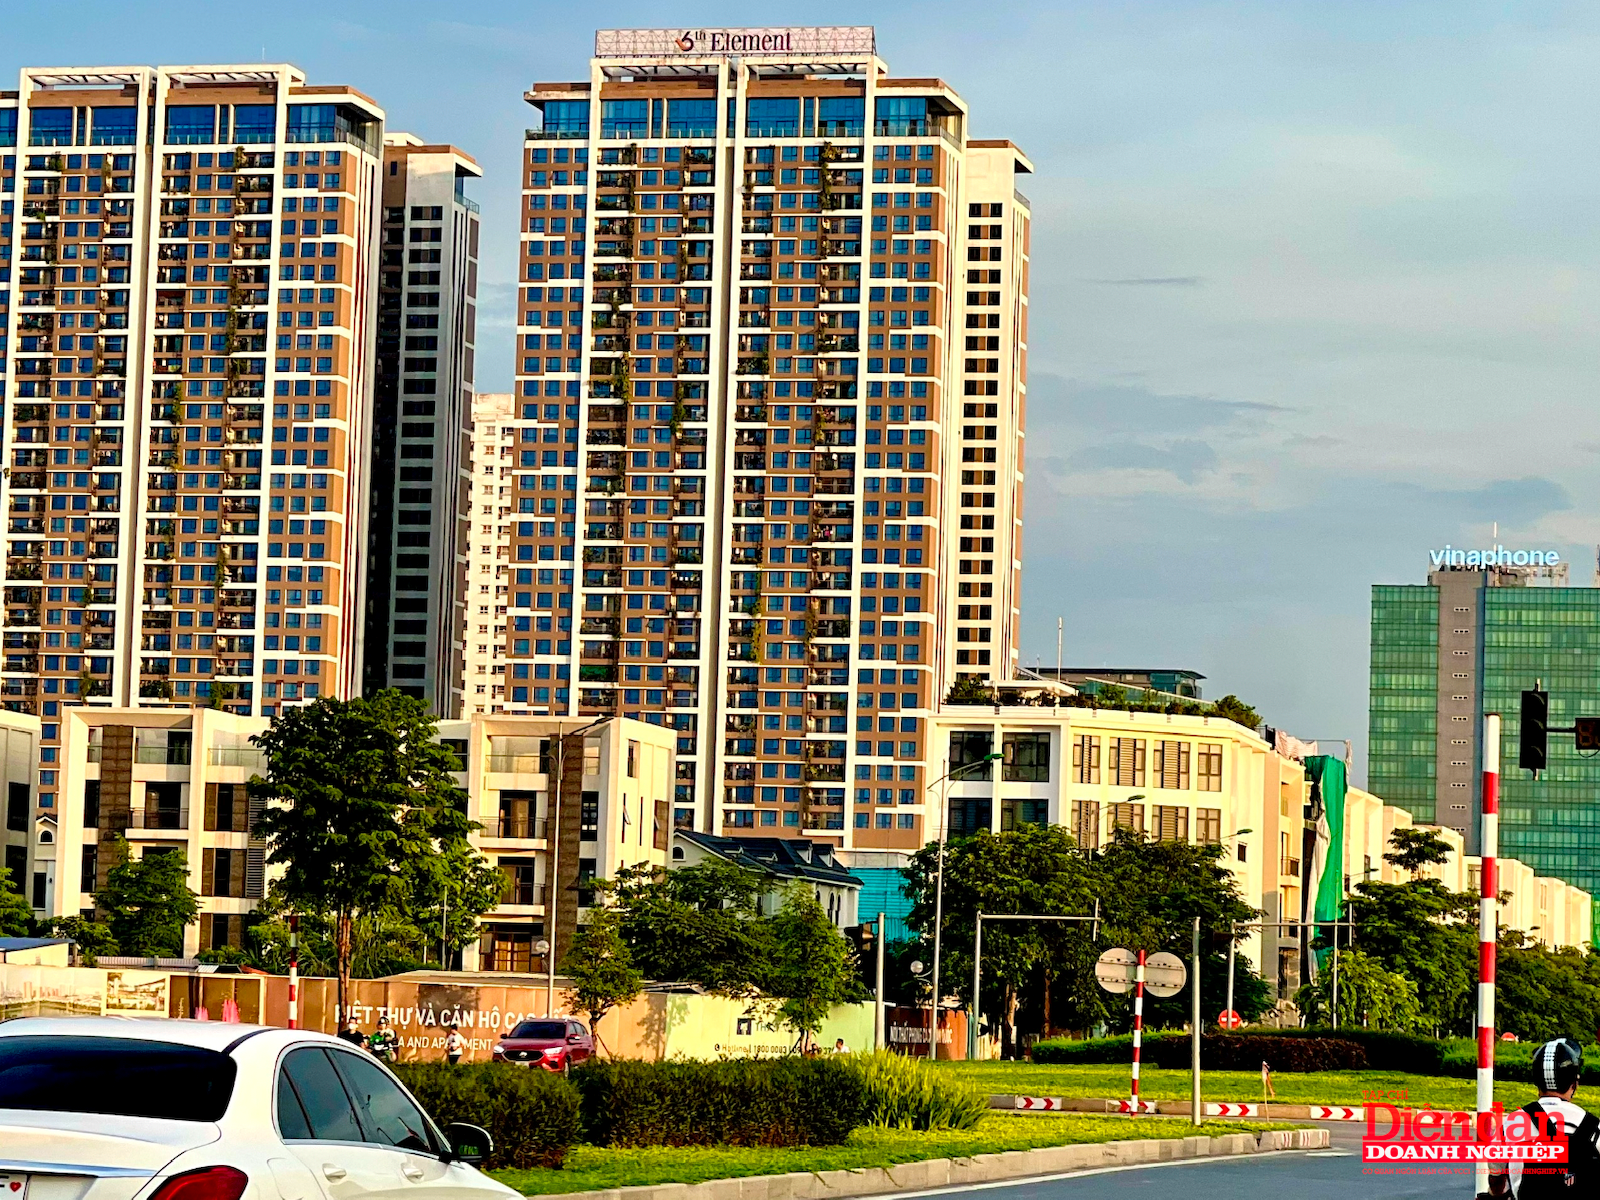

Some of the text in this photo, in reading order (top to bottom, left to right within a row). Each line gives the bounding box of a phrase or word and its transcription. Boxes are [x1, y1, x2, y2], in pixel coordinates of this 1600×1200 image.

[710, 32, 793, 51] Element
[1430, 544, 1560, 570] vinaphone
[376, 1006, 413, 1030] THỰ
[417, 1003, 436, 1026] VÀ
[440, 1004, 473, 1028] CĂN
[479, 1005, 500, 1033] HỘ
[406, 1036, 429, 1048] AND
